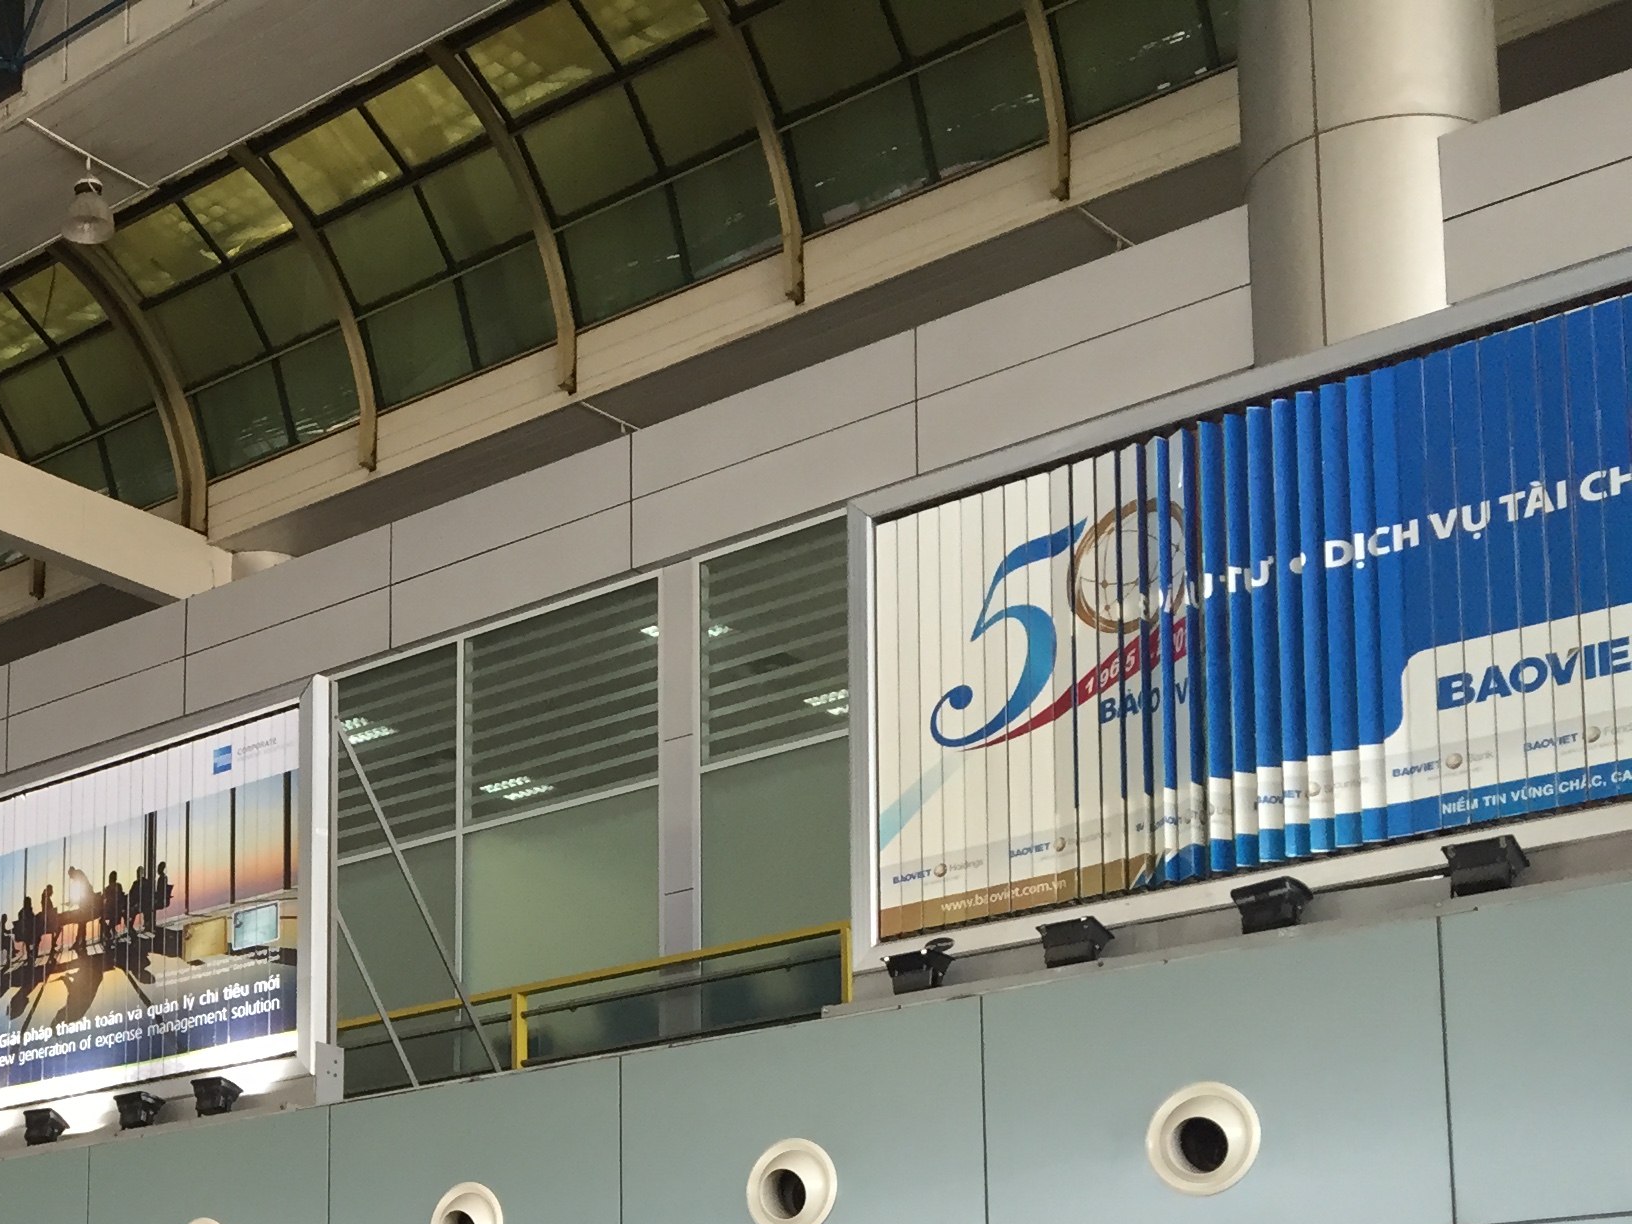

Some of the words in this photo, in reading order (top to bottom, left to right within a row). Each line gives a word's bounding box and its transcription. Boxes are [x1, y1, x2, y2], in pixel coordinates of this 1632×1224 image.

[1498, 480, 1567, 522] TÀI
[1483, 793, 1506, 806] TIN
[18, 1041, 76, 1065] generation
[79, 1035, 92, 1051] of
[95, 1027, 142, 1052] expense
[147, 1008, 227, 1039] management
[231, 998, 280, 1020] solution
[24, 1024, 53, 1046] pháp
[55, 1017, 91, 1037] thanh
[95, 1010, 122, 1029] toán
[127, 1005, 143, 1021] và
[223, 981, 249, 1001] tiêu
